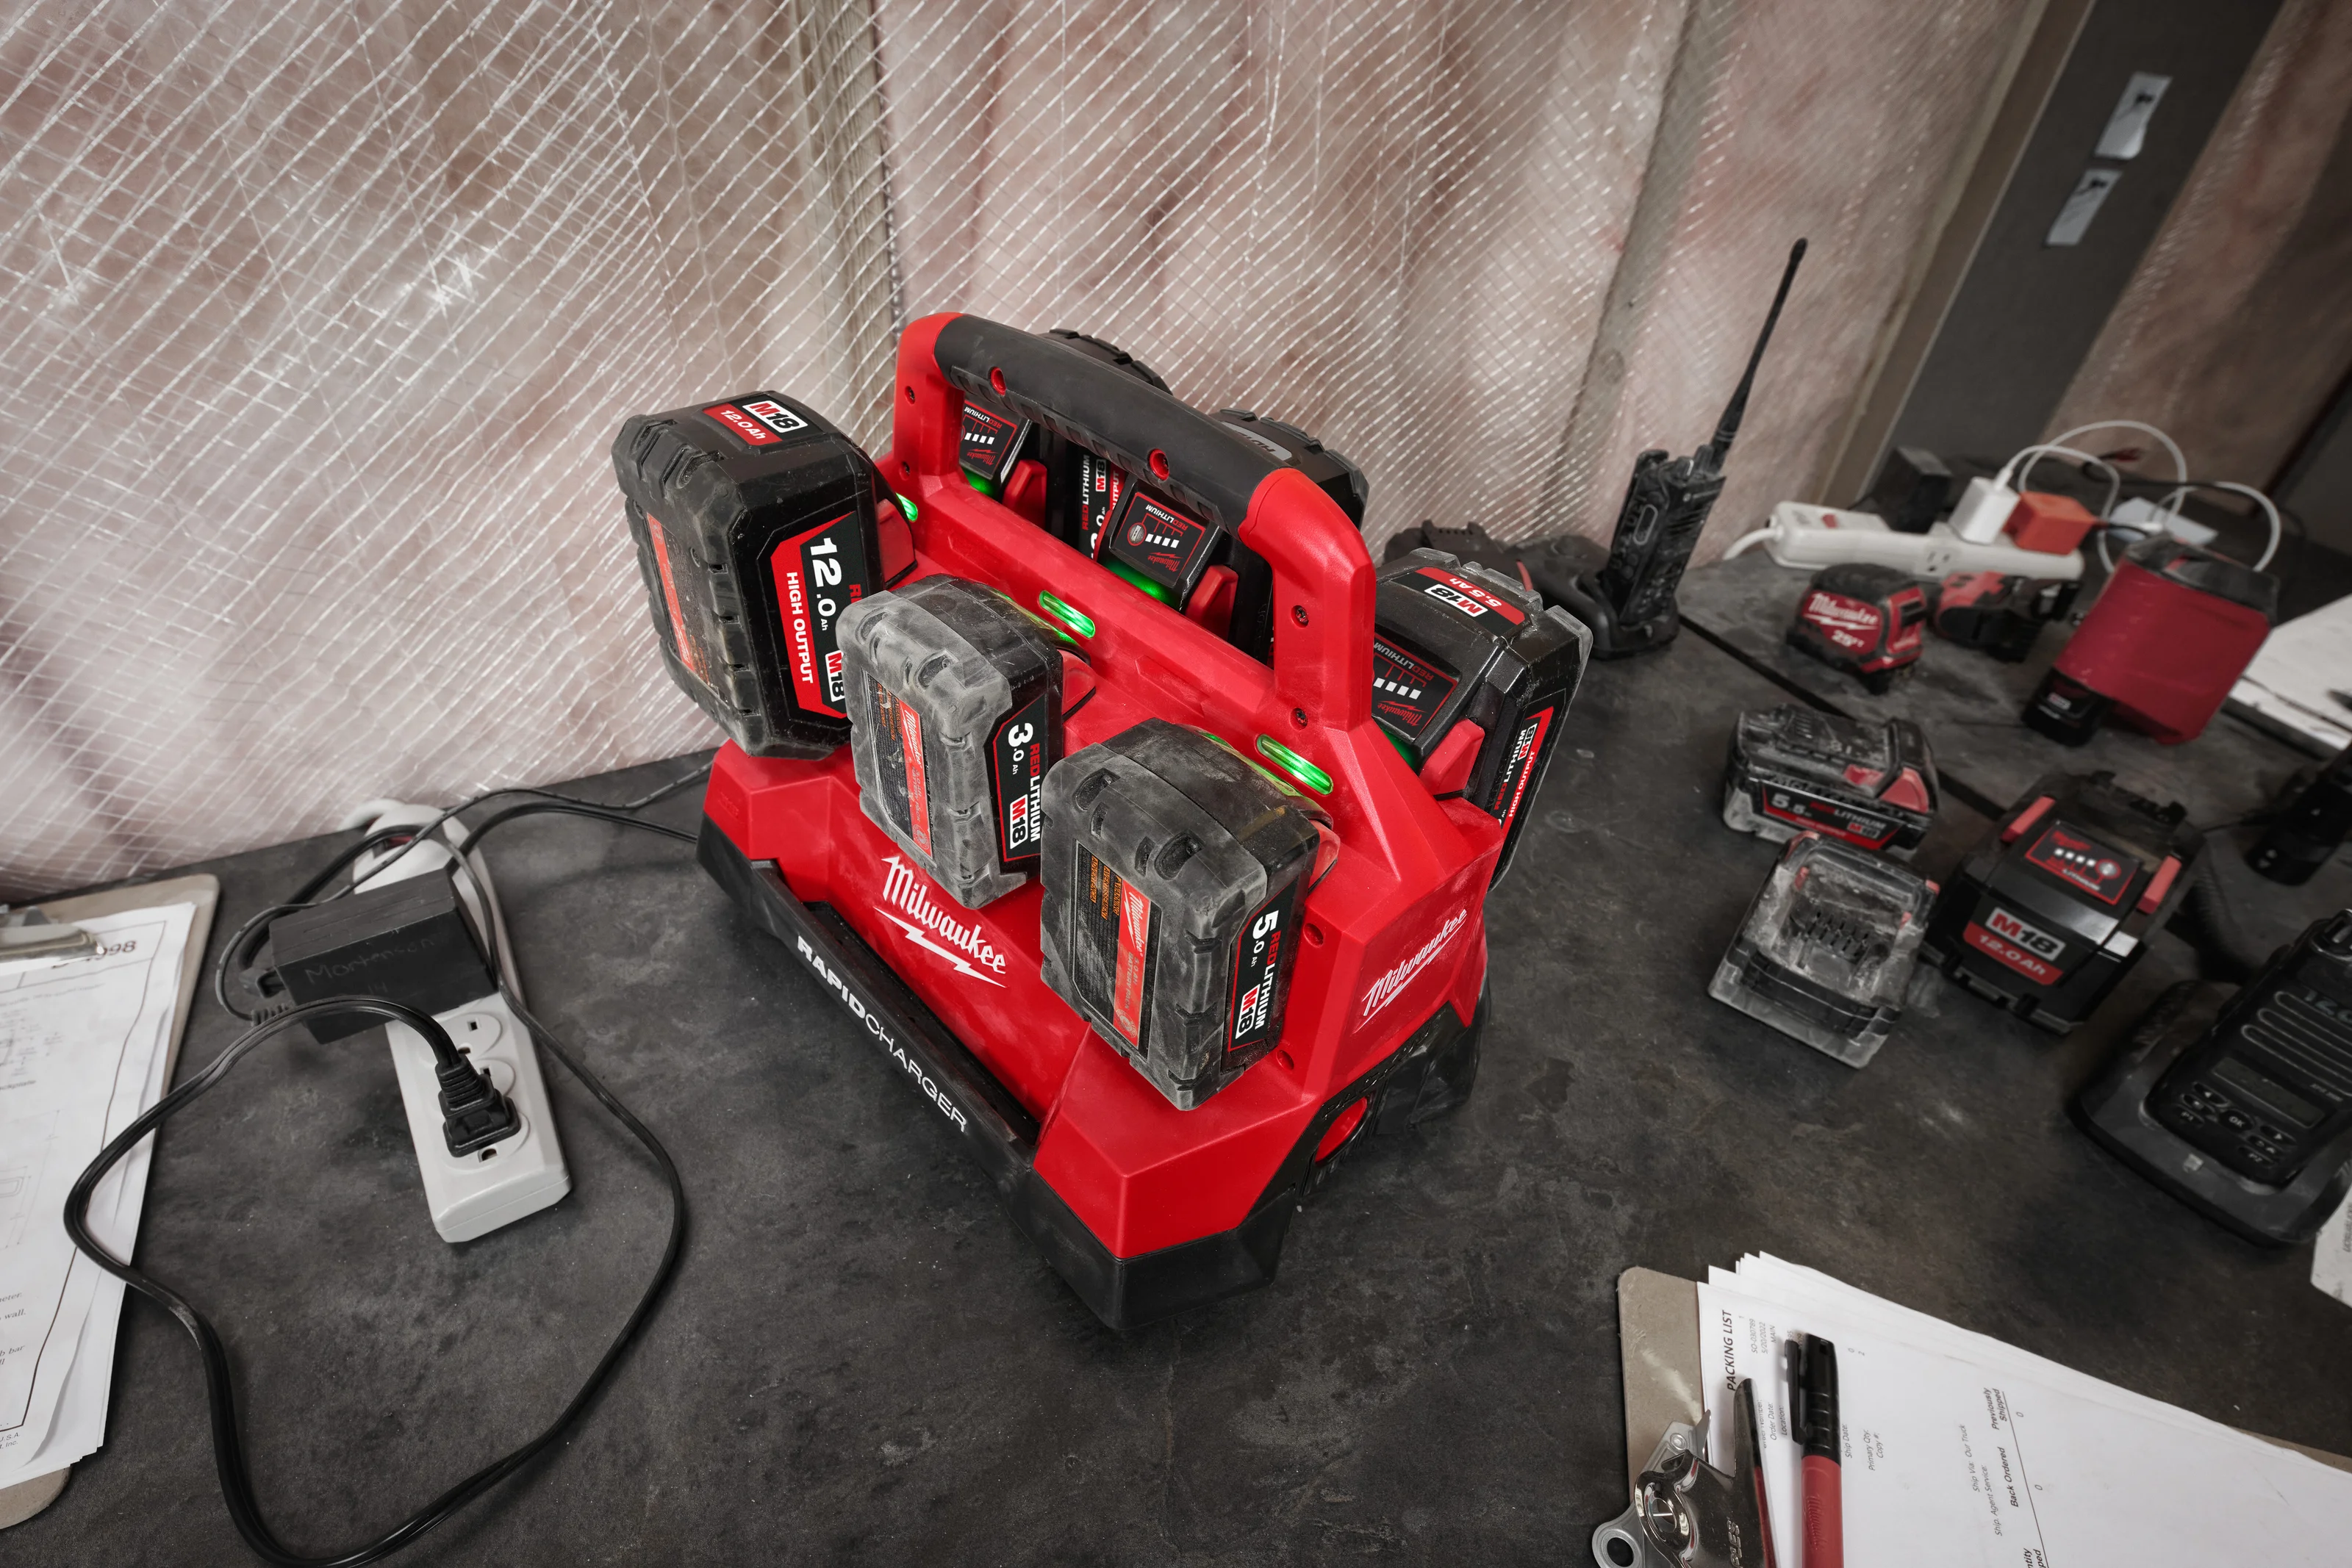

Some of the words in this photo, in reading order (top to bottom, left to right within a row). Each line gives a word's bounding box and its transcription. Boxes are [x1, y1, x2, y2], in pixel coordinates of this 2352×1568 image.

[720, 410, 766, 439] 12.0Ah
[749, 402, 800, 429] M18
[964, 406, 1003, 429] REDLITHIUM
[1096, 460, 1106, 492] M18
[1082, 454, 1090, 531] REDLITHIUM
[1145, 504, 1188, 531] REDLITHIUM
[1147, 555, 1180, 572] Milwaukee
[786, 572, 803, 615] HIGH
[1430, 587, 1486, 614] M18
[1449, 578, 1502, 608] 5.5Ah
[820, 618, 829, 631] Ah
[793, 618, 814, 684] OUTPUT
[1374, 642, 1434, 681] REDLITHIUM
[828, 651, 845, 699] M18
[1377, 702, 1421, 726] Milwaukee
[905, 709, 922, 766] Milwaukee
[1008, 722, 1033, 762] 3.0
[1520, 725, 1537, 759] M18
[1012, 764, 1019, 775] Ah
[1494, 729, 1527, 810] REDLITHIUM
[1508, 794, 1521, 818] HIGH
[1518, 751, 1535, 794] OUTPUT
[1030, 743, 1041, 842] REDLITHIUM
[1012, 796, 1027, 844] M18
[1113, 882, 1122, 915] WARNING
[881, 855, 1007, 974] Milwaukee
[1129, 891, 1145, 953] Milwaukee
[1252, 910, 1279, 954] 5.0
[1990, 912, 2059, 955] M18
[1251, 956, 1258, 968] Ah
[1361, 908, 1467, 1017] Milwaukee
[1979, 934, 2046, 976] 12.0Ah
[1255, 930, 1281, 1029] REDLITHIUM
[1238, 987, 1258, 1034] M18
[2228, 1115, 2245, 1128] OK
[4, 1309, 26, 1320] wall.
[1721, 1309, 1734, 1335] LIST
[8, 1345, 25, 1355] bar
[1723, 1337, 1737, 1392] PACKING
[1779, 1405, 1788, 1436] Location:
[1983, 1387, 2000, 1431] Previously
[1992, 1388, 2007, 1423] Shipped
[5, 1440, 18, 1448] Inc.
[1769, 1419, 1777, 1441] Order
[1960, 1425, 1970, 1443] Truck
[1844, 1442, 1853, 1459] Ship
[1865, 1445, 1875, 1471] Primary
[1876, 1441, 1884, 1459] Copy
[1964, 1444, 1973, 1458] Our
[1969, 1460, 1977, 1475] Via:
[1981, 1464, 1993, 1493] Service:
[1997, 1447, 2012, 1484] Ordered
[1972, 1475, 1980, 1493] Ship
[2007, 1484, 2019, 1508] Back
[1987, 1493, 1999, 1517] Agent
